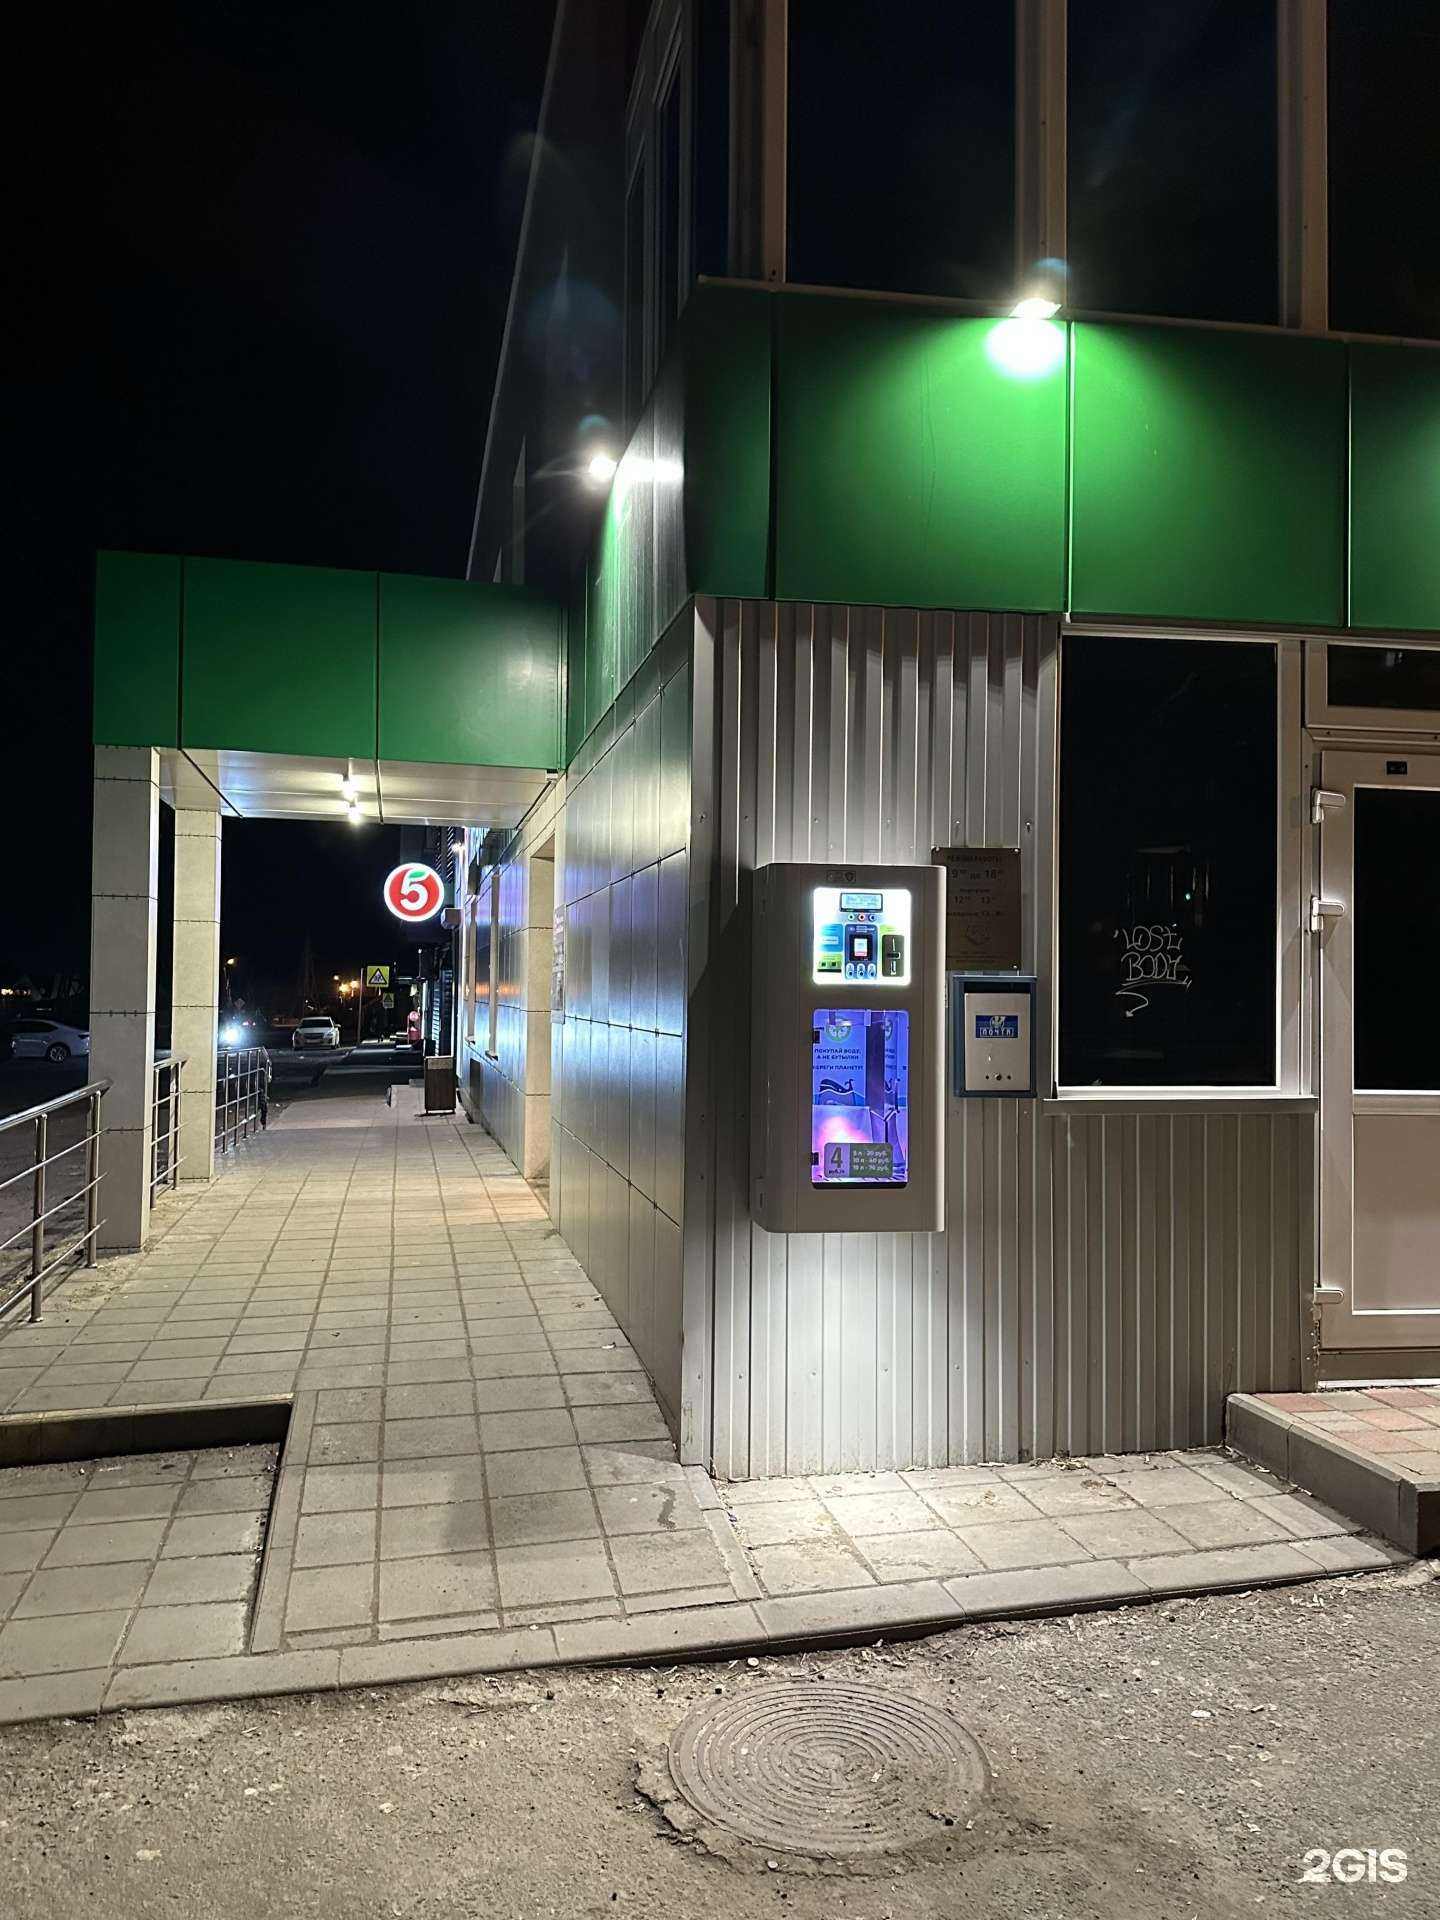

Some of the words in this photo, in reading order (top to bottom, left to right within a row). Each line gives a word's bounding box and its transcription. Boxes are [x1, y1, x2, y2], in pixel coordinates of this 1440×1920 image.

[400, 867, 430, 911] 5
[1121, 951, 1184, 982] BODY
[831, 1147, 843, 1168] 4
